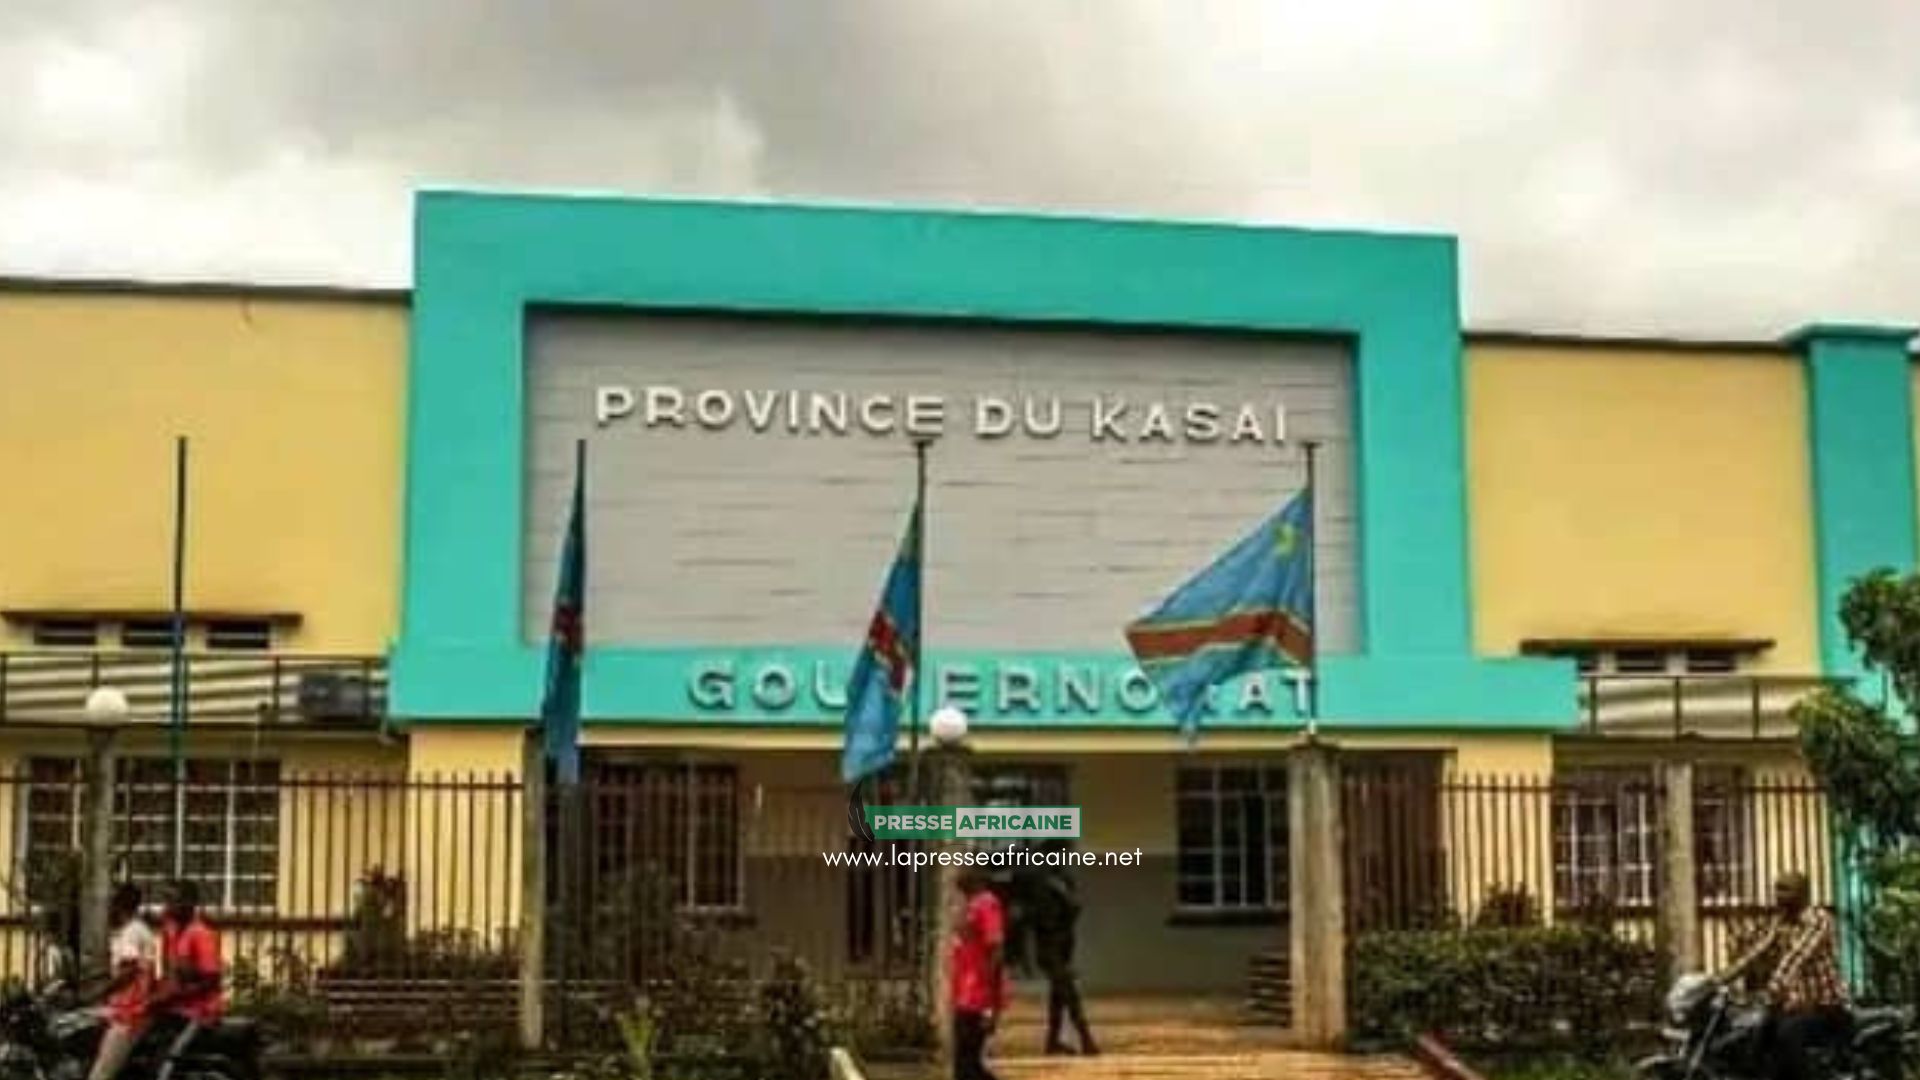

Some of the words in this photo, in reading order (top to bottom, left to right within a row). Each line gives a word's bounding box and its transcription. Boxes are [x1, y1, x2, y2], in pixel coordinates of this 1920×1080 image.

[595, 385, 946, 437] PROVINCE
[975, 399, 1062, 438] DU
[1091, 401, 1288, 444] KASAI
[690, 661, 1314, 714] GOUERNOAT
